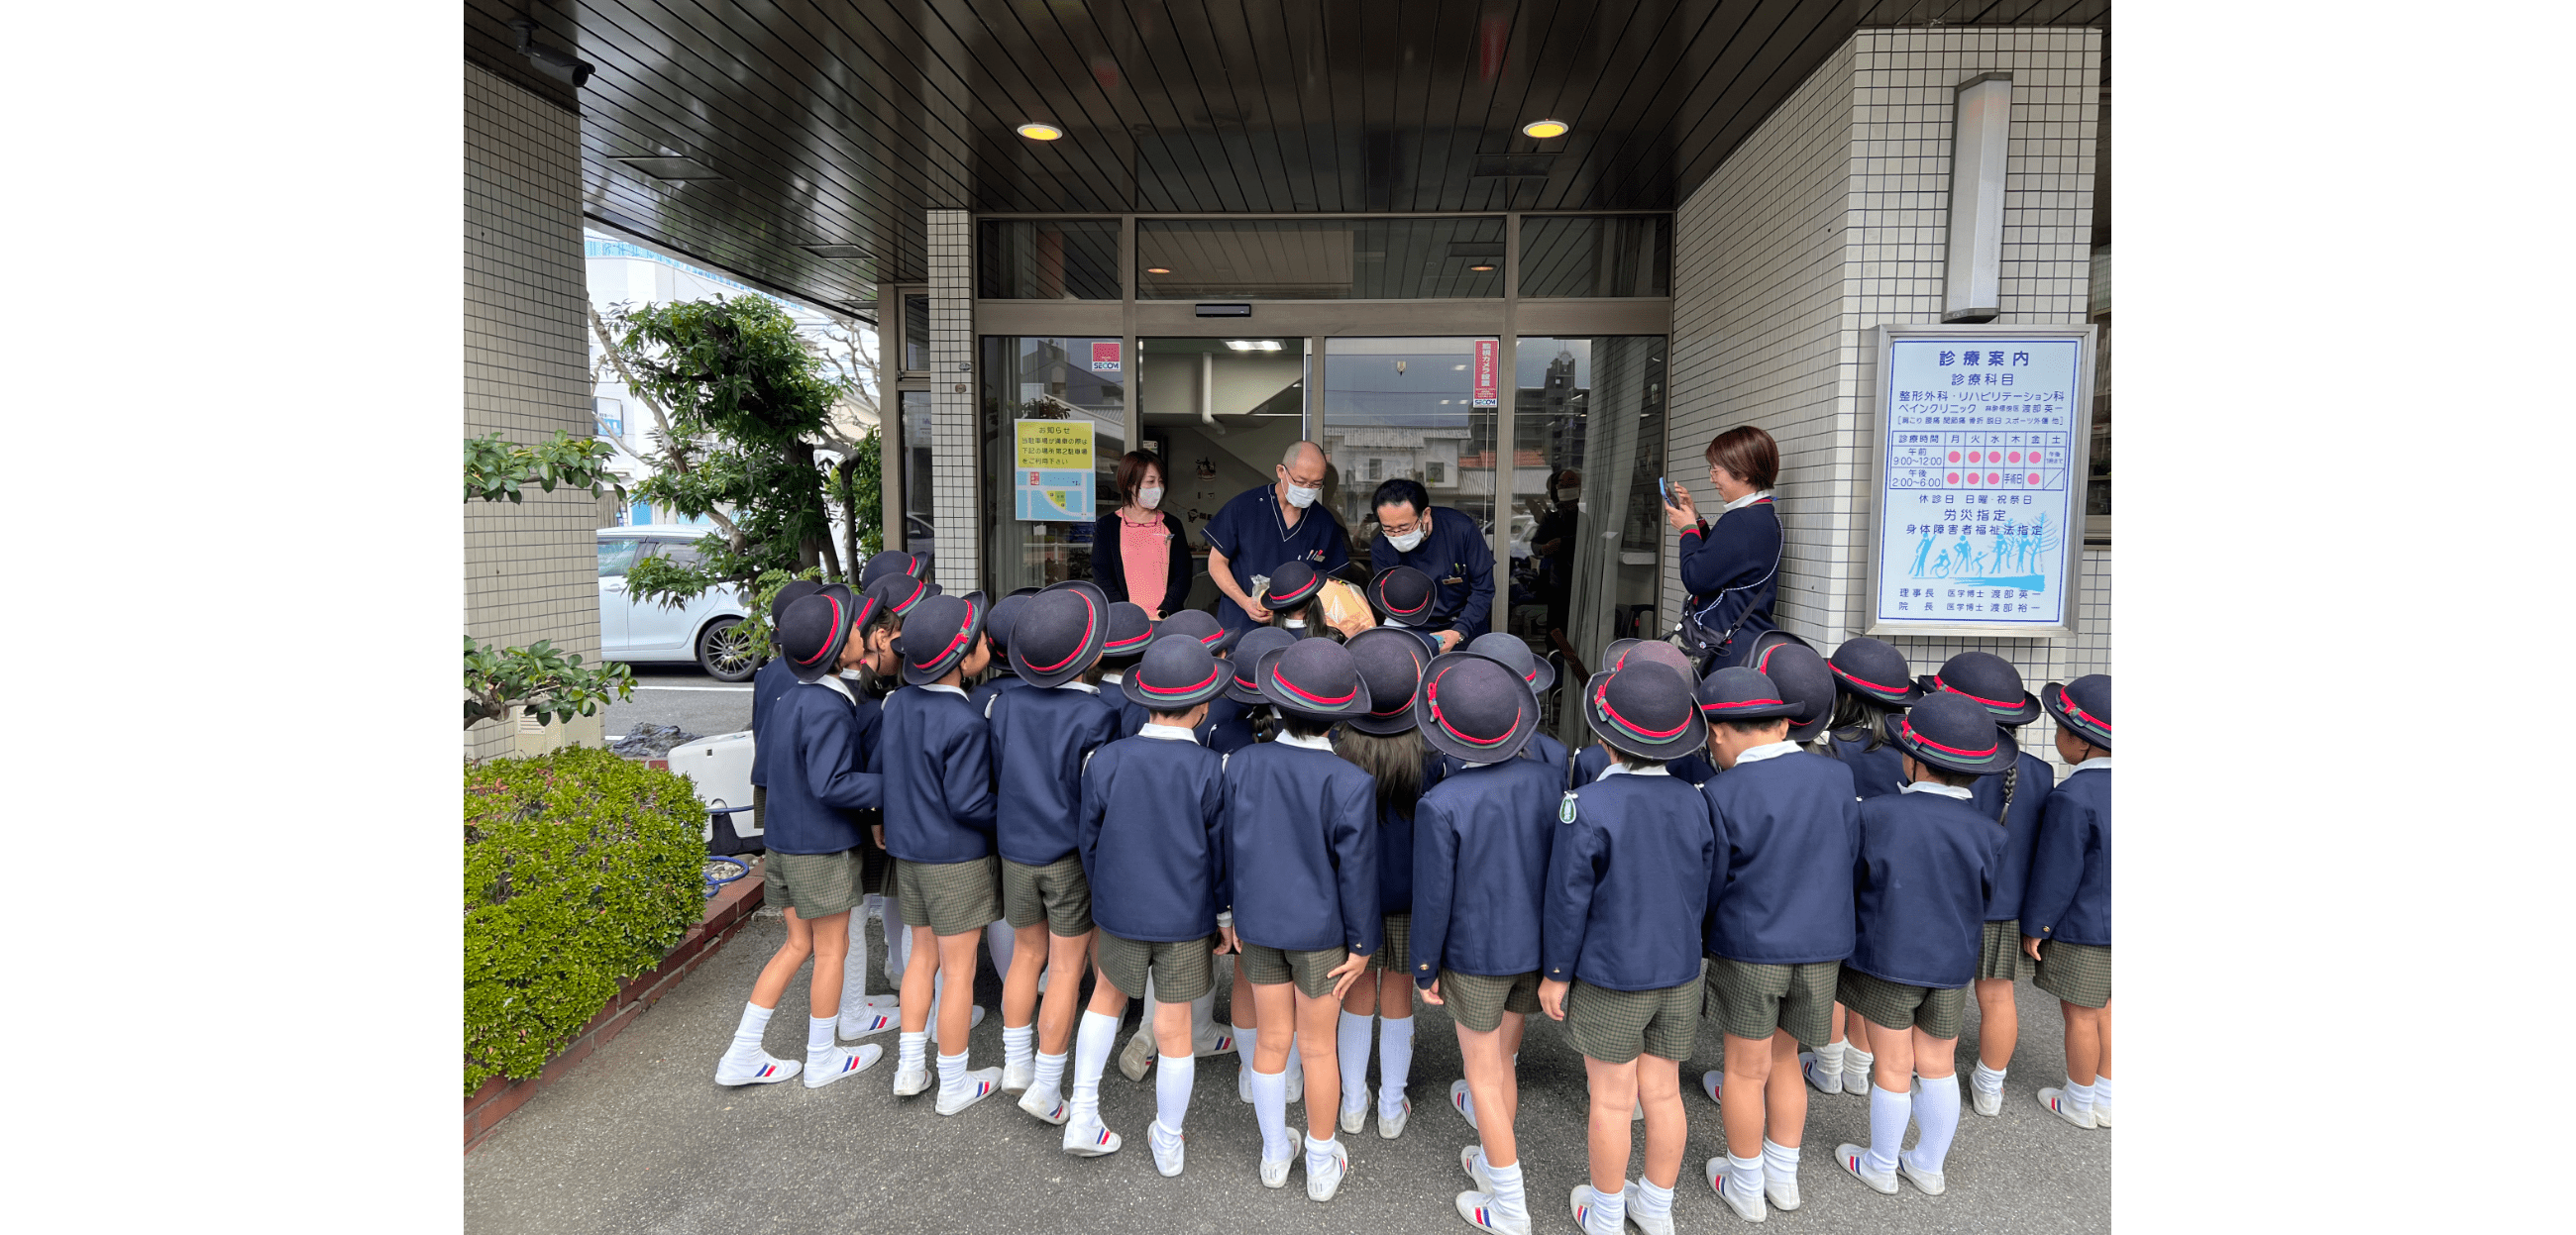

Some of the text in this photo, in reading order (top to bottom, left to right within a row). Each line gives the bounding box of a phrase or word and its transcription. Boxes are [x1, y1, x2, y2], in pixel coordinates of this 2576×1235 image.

[1939, 351, 2029, 366] 診療案内
[1952, 373, 2014, 386] 診療科目
[1898, 403, 1977, 414] ペインクリニック
[1039, 426, 1070, 435] お知らせ
[1898, 434, 2061, 444] 診療時間 月 火 水 木 金 土
[1908, 447, 1927, 457] 午前
[1908, 468, 1927, 477] 午後
[2004, 473, 2022, 484] 手術日
[1919, 494, 1954, 503] 休診日
[1944, 509, 2006, 521] 労災指定
[1906, 525, 2043, 536] 身体障害者福祉法指定
[1899, 588, 1934, 598] 理事長
[1948, 589, 1985, 598] 医学博士
[1947, 603, 1984, 612] 医学博士
